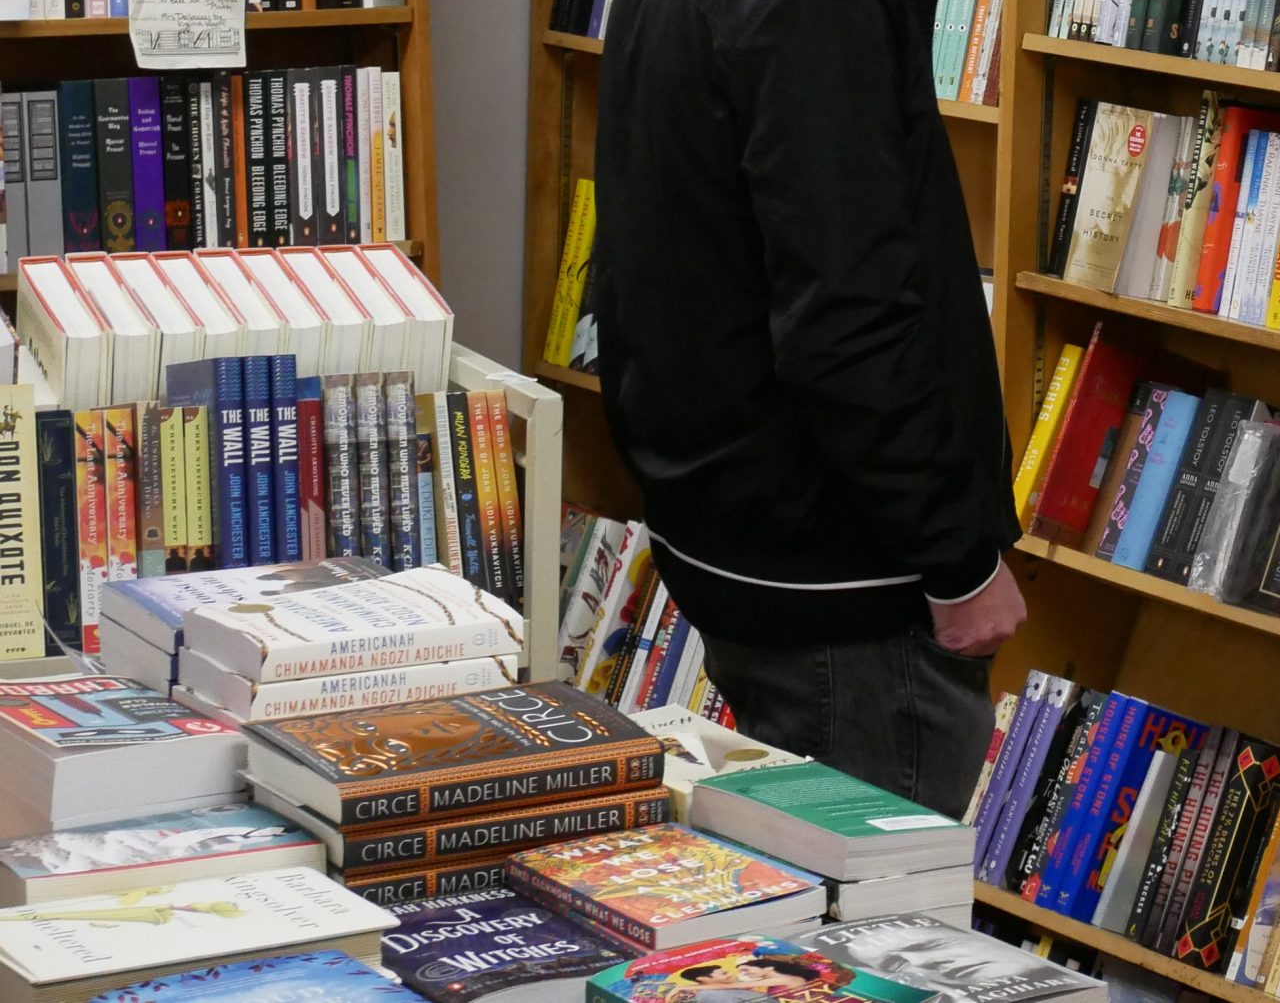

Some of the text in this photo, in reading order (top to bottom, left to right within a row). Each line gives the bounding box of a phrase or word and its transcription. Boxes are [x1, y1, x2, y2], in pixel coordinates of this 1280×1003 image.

[249, 79, 266, 233] THOMAS PYNCHON BLEEDING EDGE
[1089, 208, 1122, 222] SECRET
[1082, 229, 1119, 243] HISTORY
[1039, 357, 1070, 422] FLIGHTS
[222, 409, 242, 424] THE
[223, 426, 243, 467] WALL
[1192, 404, 1219, 467] LEO TOLSTOY
[229, 475, 243, 559] JOHN LANCHESTER
[2, 490, 25, 586] QUIXOTE
[489, 534, 502, 589] YUKNAVITCH
[275, 642, 465, 678] CHIMAMANDA NGOZI ADICHIE
[330, 633, 415, 656] AMERICANAH
[320, 673, 407, 694] AMERICANAH
[480, 689, 592, 743] CIRCE
[355, 778, 538, 819] CIRCE MADELINE
[546, 766, 612, 795] MILLER
[361, 822, 545, 861] CIRCE MADELINE
[553, 810, 619, 839] MILLER
[556, 833, 655, 860] WHAT
[603, 850, 641, 864] WE
[612, 856, 700, 885] LOSE
[276, 872, 349, 915] Barbara
[649, 880, 798, 924] CLEMMONS
[383, 914, 542, 956] DISCOVERY
[500, 934, 523, 946] OF
[817, 916, 941, 948] LITTLE
[440, 939, 580, 974] WITCHES
